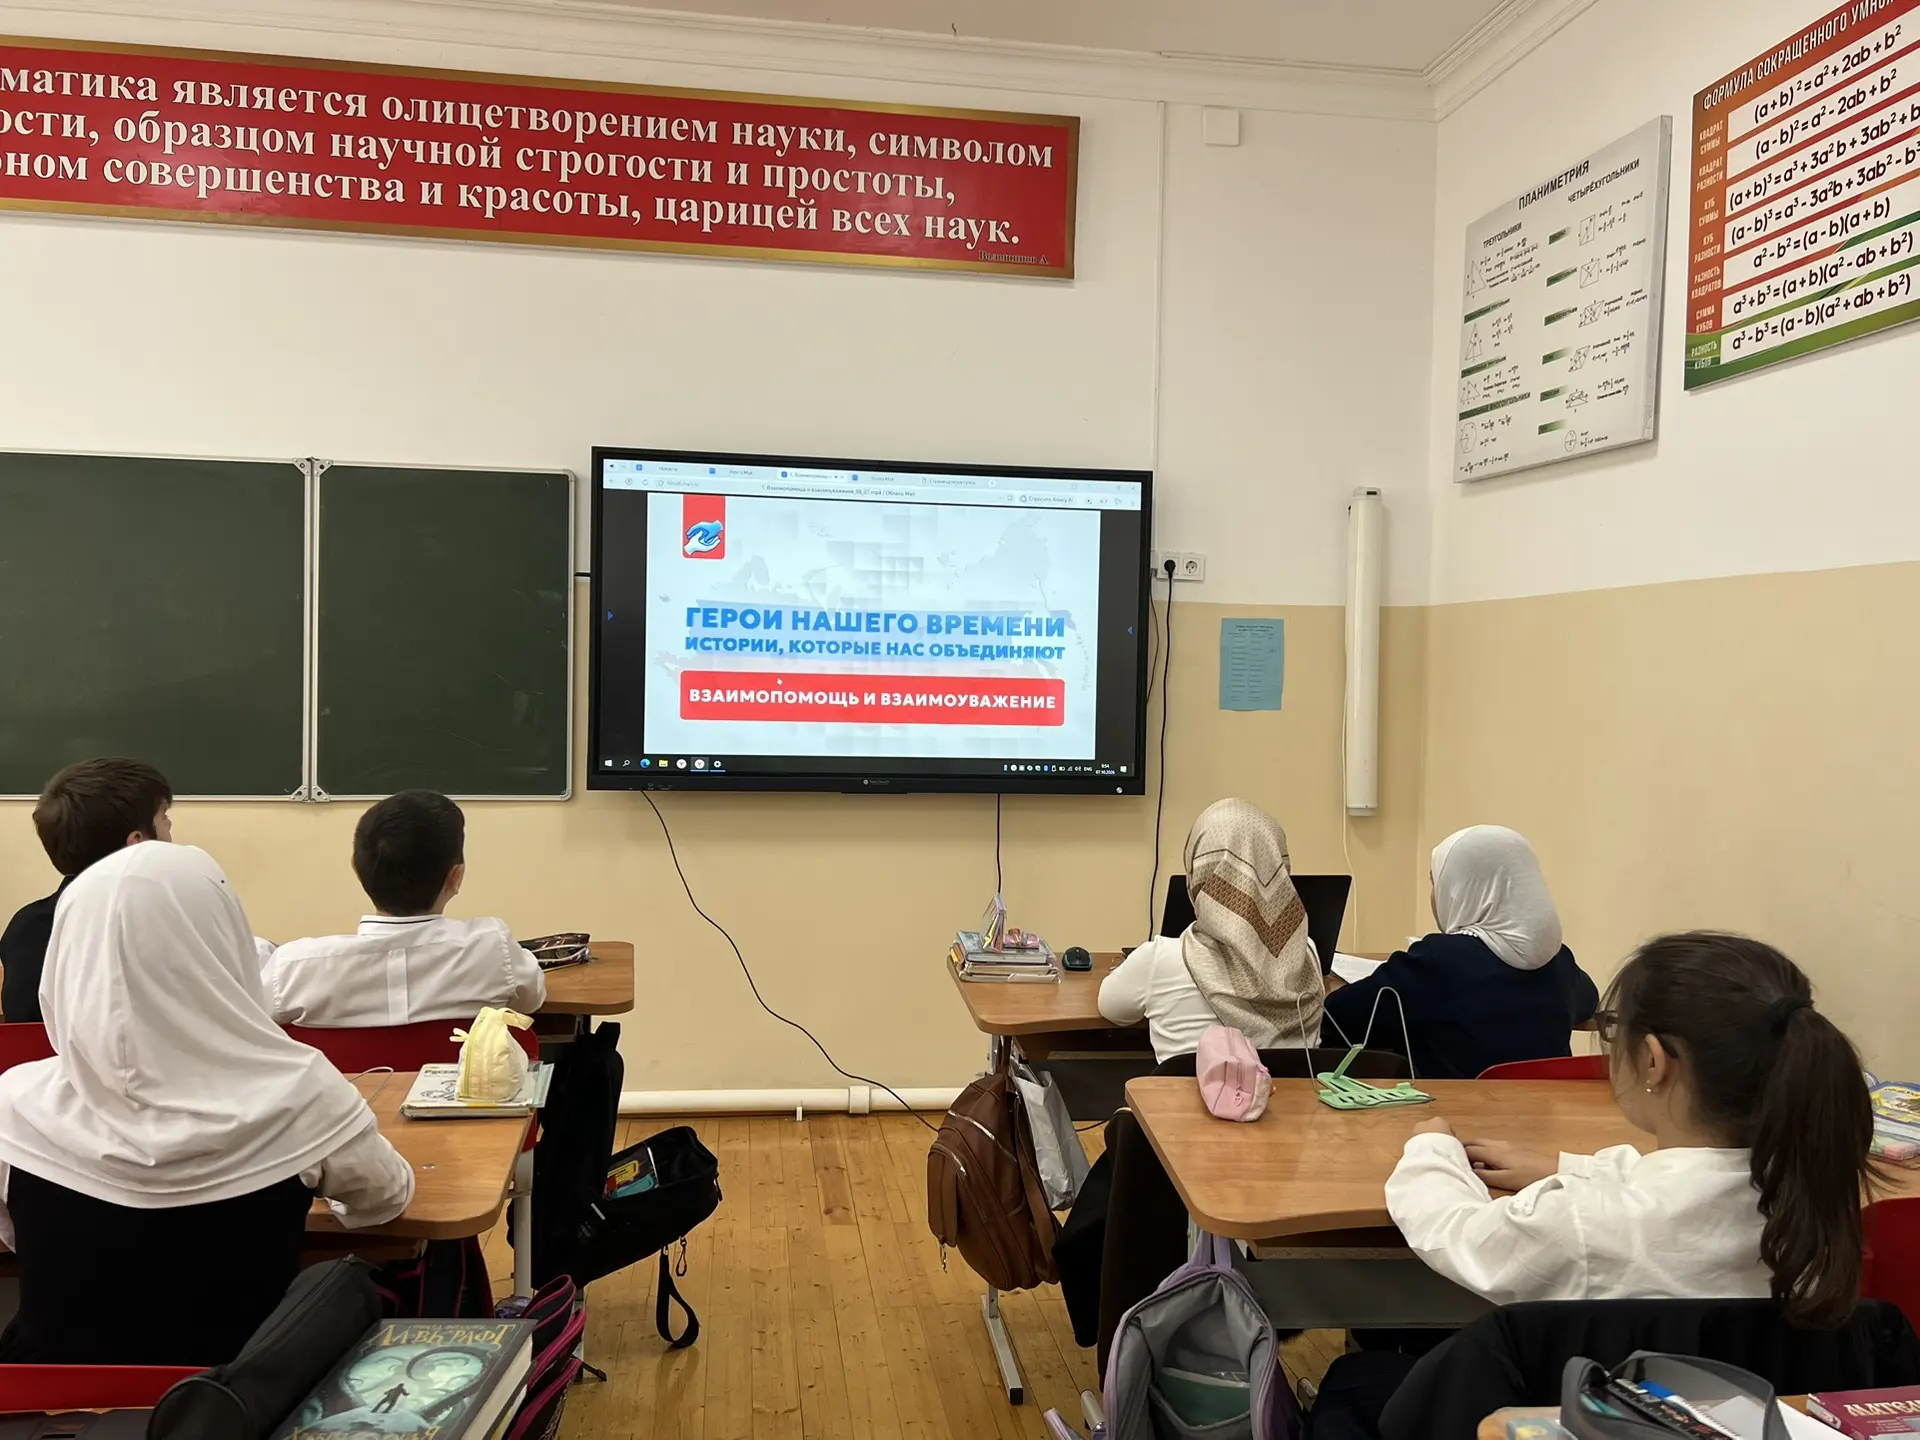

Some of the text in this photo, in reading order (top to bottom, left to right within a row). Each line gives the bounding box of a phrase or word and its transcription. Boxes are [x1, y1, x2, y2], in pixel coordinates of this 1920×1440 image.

[1703, 67, 1753, 110] ФОРМУЛА
[1757, 12, 1847, 80] СОКРАЩЕННОГО
[0, 67, 1052, 167] матика является олицетворением науки, символом
[1700, 120, 1723, 141] КВАДРАТ
[0, 109, 955, 206] ости, образцом научной строгости и простоты,
[1699, 157, 1723, 176] КВАДРАТ
[0, 152, 1019, 250] ном совершенства и красоты, царицей всех наук.
[1519, 160, 1589, 210] ПЛАНИМЕТРИЯ
[686, 607, 1065, 637] ГЕРОИ НАШЕГО ВРЕМЕНИ
[685, 636, 1066, 661] ИСТОРИИ, КОТОРЫЕ НАС ОБЪЕДИНЯЮТ
[689, 688, 1056, 709] ВЗАИМОПОМОЩЬ И ВЗАИМОУВАЖЕНИЕ
